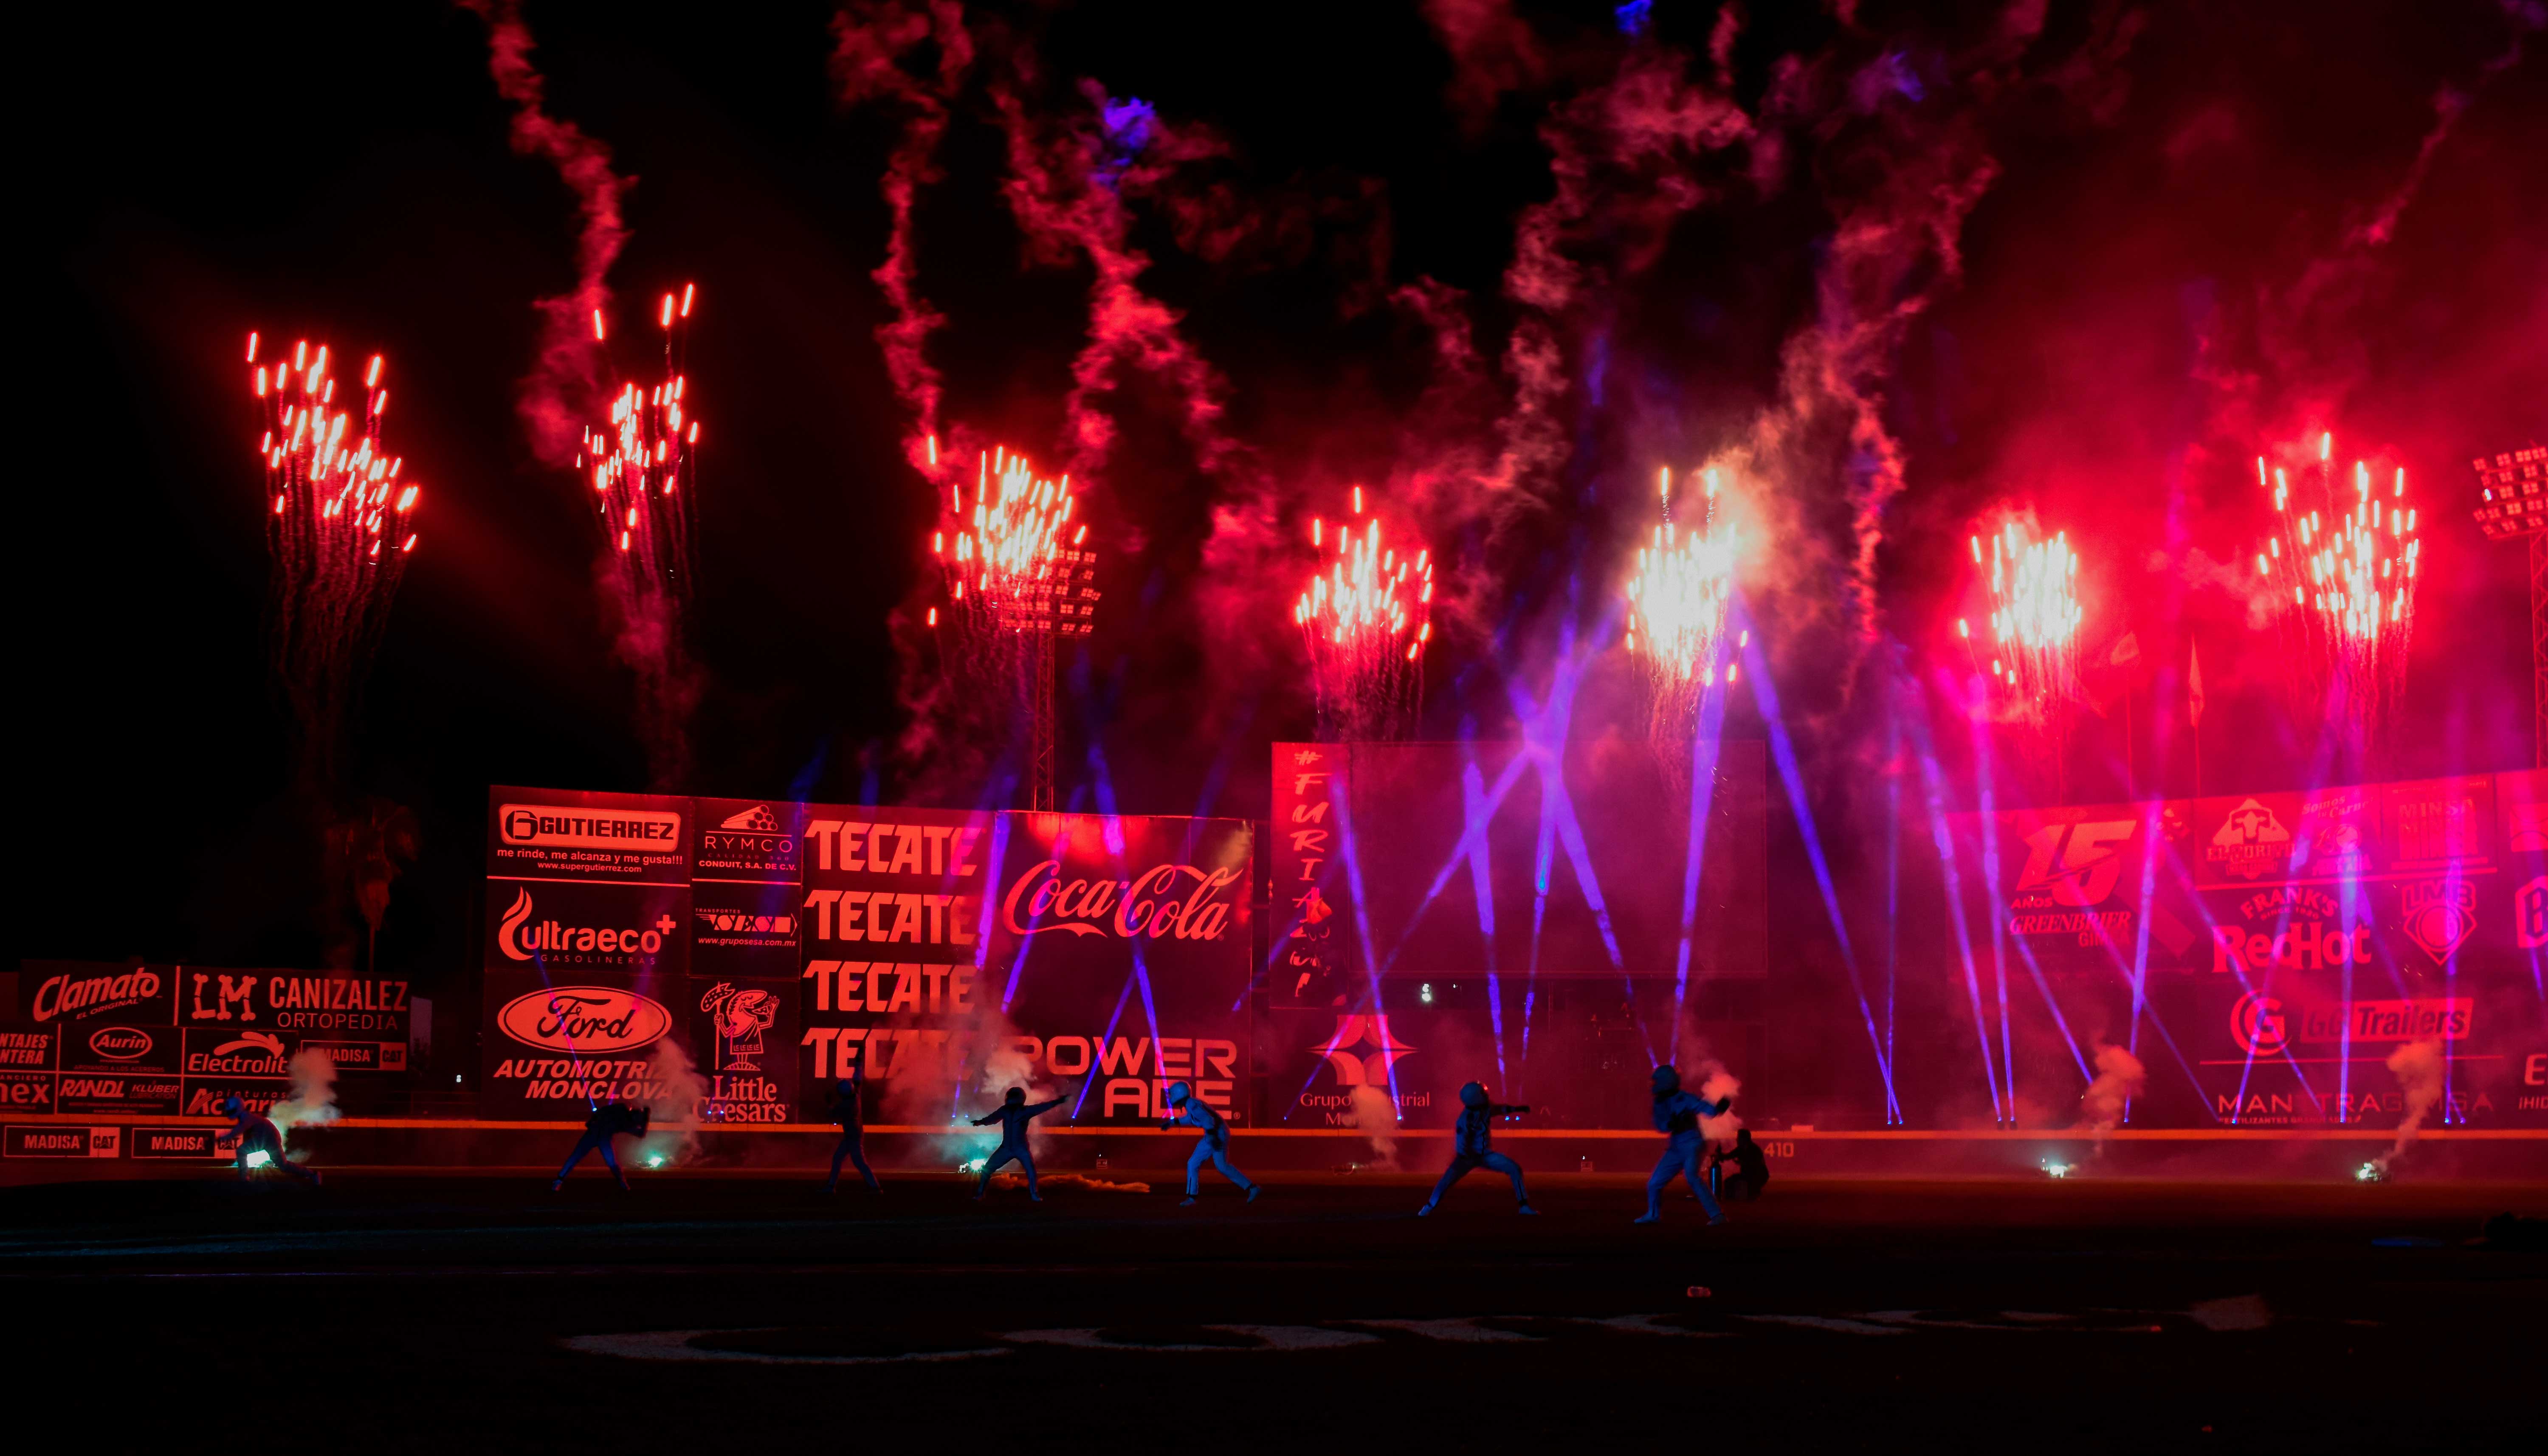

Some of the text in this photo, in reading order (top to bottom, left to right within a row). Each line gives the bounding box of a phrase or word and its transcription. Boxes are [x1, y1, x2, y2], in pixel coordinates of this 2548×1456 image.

[539, 817, 674, 840] GUTIERREZ
[705, 836, 792, 853] RYMCO
[804, 820, 981, 876] TECATE
[517, 849, 548, 860] rinde,
[551, 851, 568, 859] me
[571, 851, 611, 862] alcanza
[614, 854, 620, 863] y
[643, 855, 683, 865] gusta!!!
[537, 861, 642, 873] www.supergutierrez.com
[699, 860, 742, 869] CONDUIT,
[2016, 820, 2136, 907] 15
[1003, 859, 1244, 940] Coca-Cola
[2240, 887, 2339, 921] FRANK'S
[803, 890, 980, 945] TECATE
[2010, 912, 2132, 935] GREENBRIER
[698, 938, 797, 947] www.gruposesa.com.mx
[541, 955, 656, 964] GASOLINERAS
[32, 967, 160, 1022] Clamato
[270, 977, 408, 1011] CANIZALEZ
[803, 960, 980, 1014] TECATE
[90, 998, 140, 1014] ORIGINAL
[277, 1012, 398, 1030] ORTOPEDIA
[537, 996, 636, 1039] Ford
[2356, 1005, 2466, 1036] Trailers
[96, 1034, 147, 1049] Aurin
[188, 1053, 288, 1073] Electrolit
[382, 1050, 403, 1062] CAT
[59, 1079, 125, 1098] RANDL
[525, 1080, 674, 1100] MONCLOVA
[712, 1075, 778, 1102] Little
[692, 1096, 787, 1122] Caesars
[1300, 1092, 1352, 1110] Grupo
[24, 1135, 116, 1149] MADISA CAT
[151, 1136, 206, 1151] MADISA
[1764, 1142, 1794, 1157] 410
